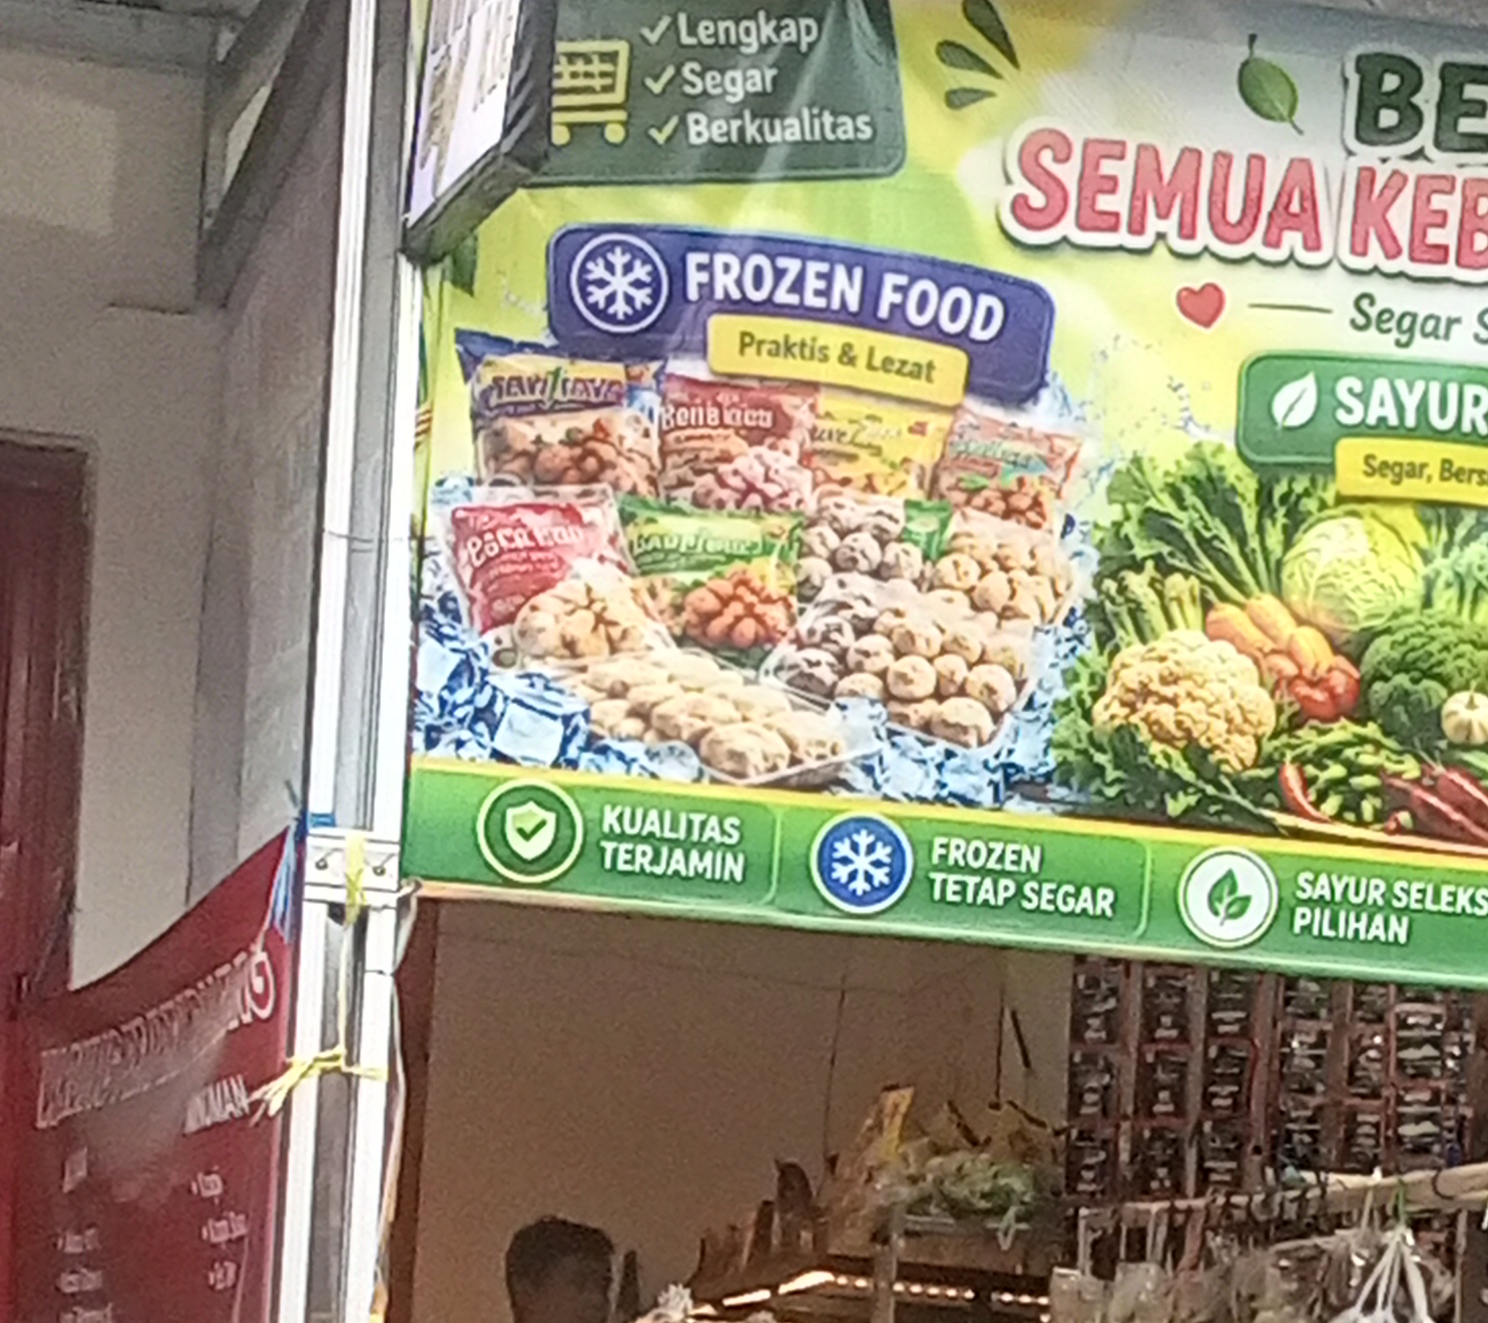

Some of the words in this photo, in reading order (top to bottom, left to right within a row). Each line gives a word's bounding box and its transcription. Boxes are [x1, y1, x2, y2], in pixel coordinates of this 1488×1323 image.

[678, 12, 819, 48] Lengkap
[681, 63, 779, 102] Segar
[686, 110, 875, 148] Berkualitas
[1010, 127, 1324, 253] SEMUA
[685, 250, 866, 315] FROZEN
[876, 277, 1006, 344] FOOD
[1349, 292, 1461, 348] Segar
[738, 330, 831, 364] Praktis
[838, 341, 860, 369] &
[866, 348, 938, 385] Lezat
[1362, 453, 1434, 486] Segar,
[603, 804, 742, 845] KUALITAS
[600, 839, 746, 884] TERJAMIN
[930, 837, 1043, 875] FROZEN
[928, 872, 1017, 910] TETAP
[1021, 884, 1116, 920] SEGAR
[1295, 871, 1387, 910] SAYUR
[1292, 908, 1411, 946] PILIHAN
